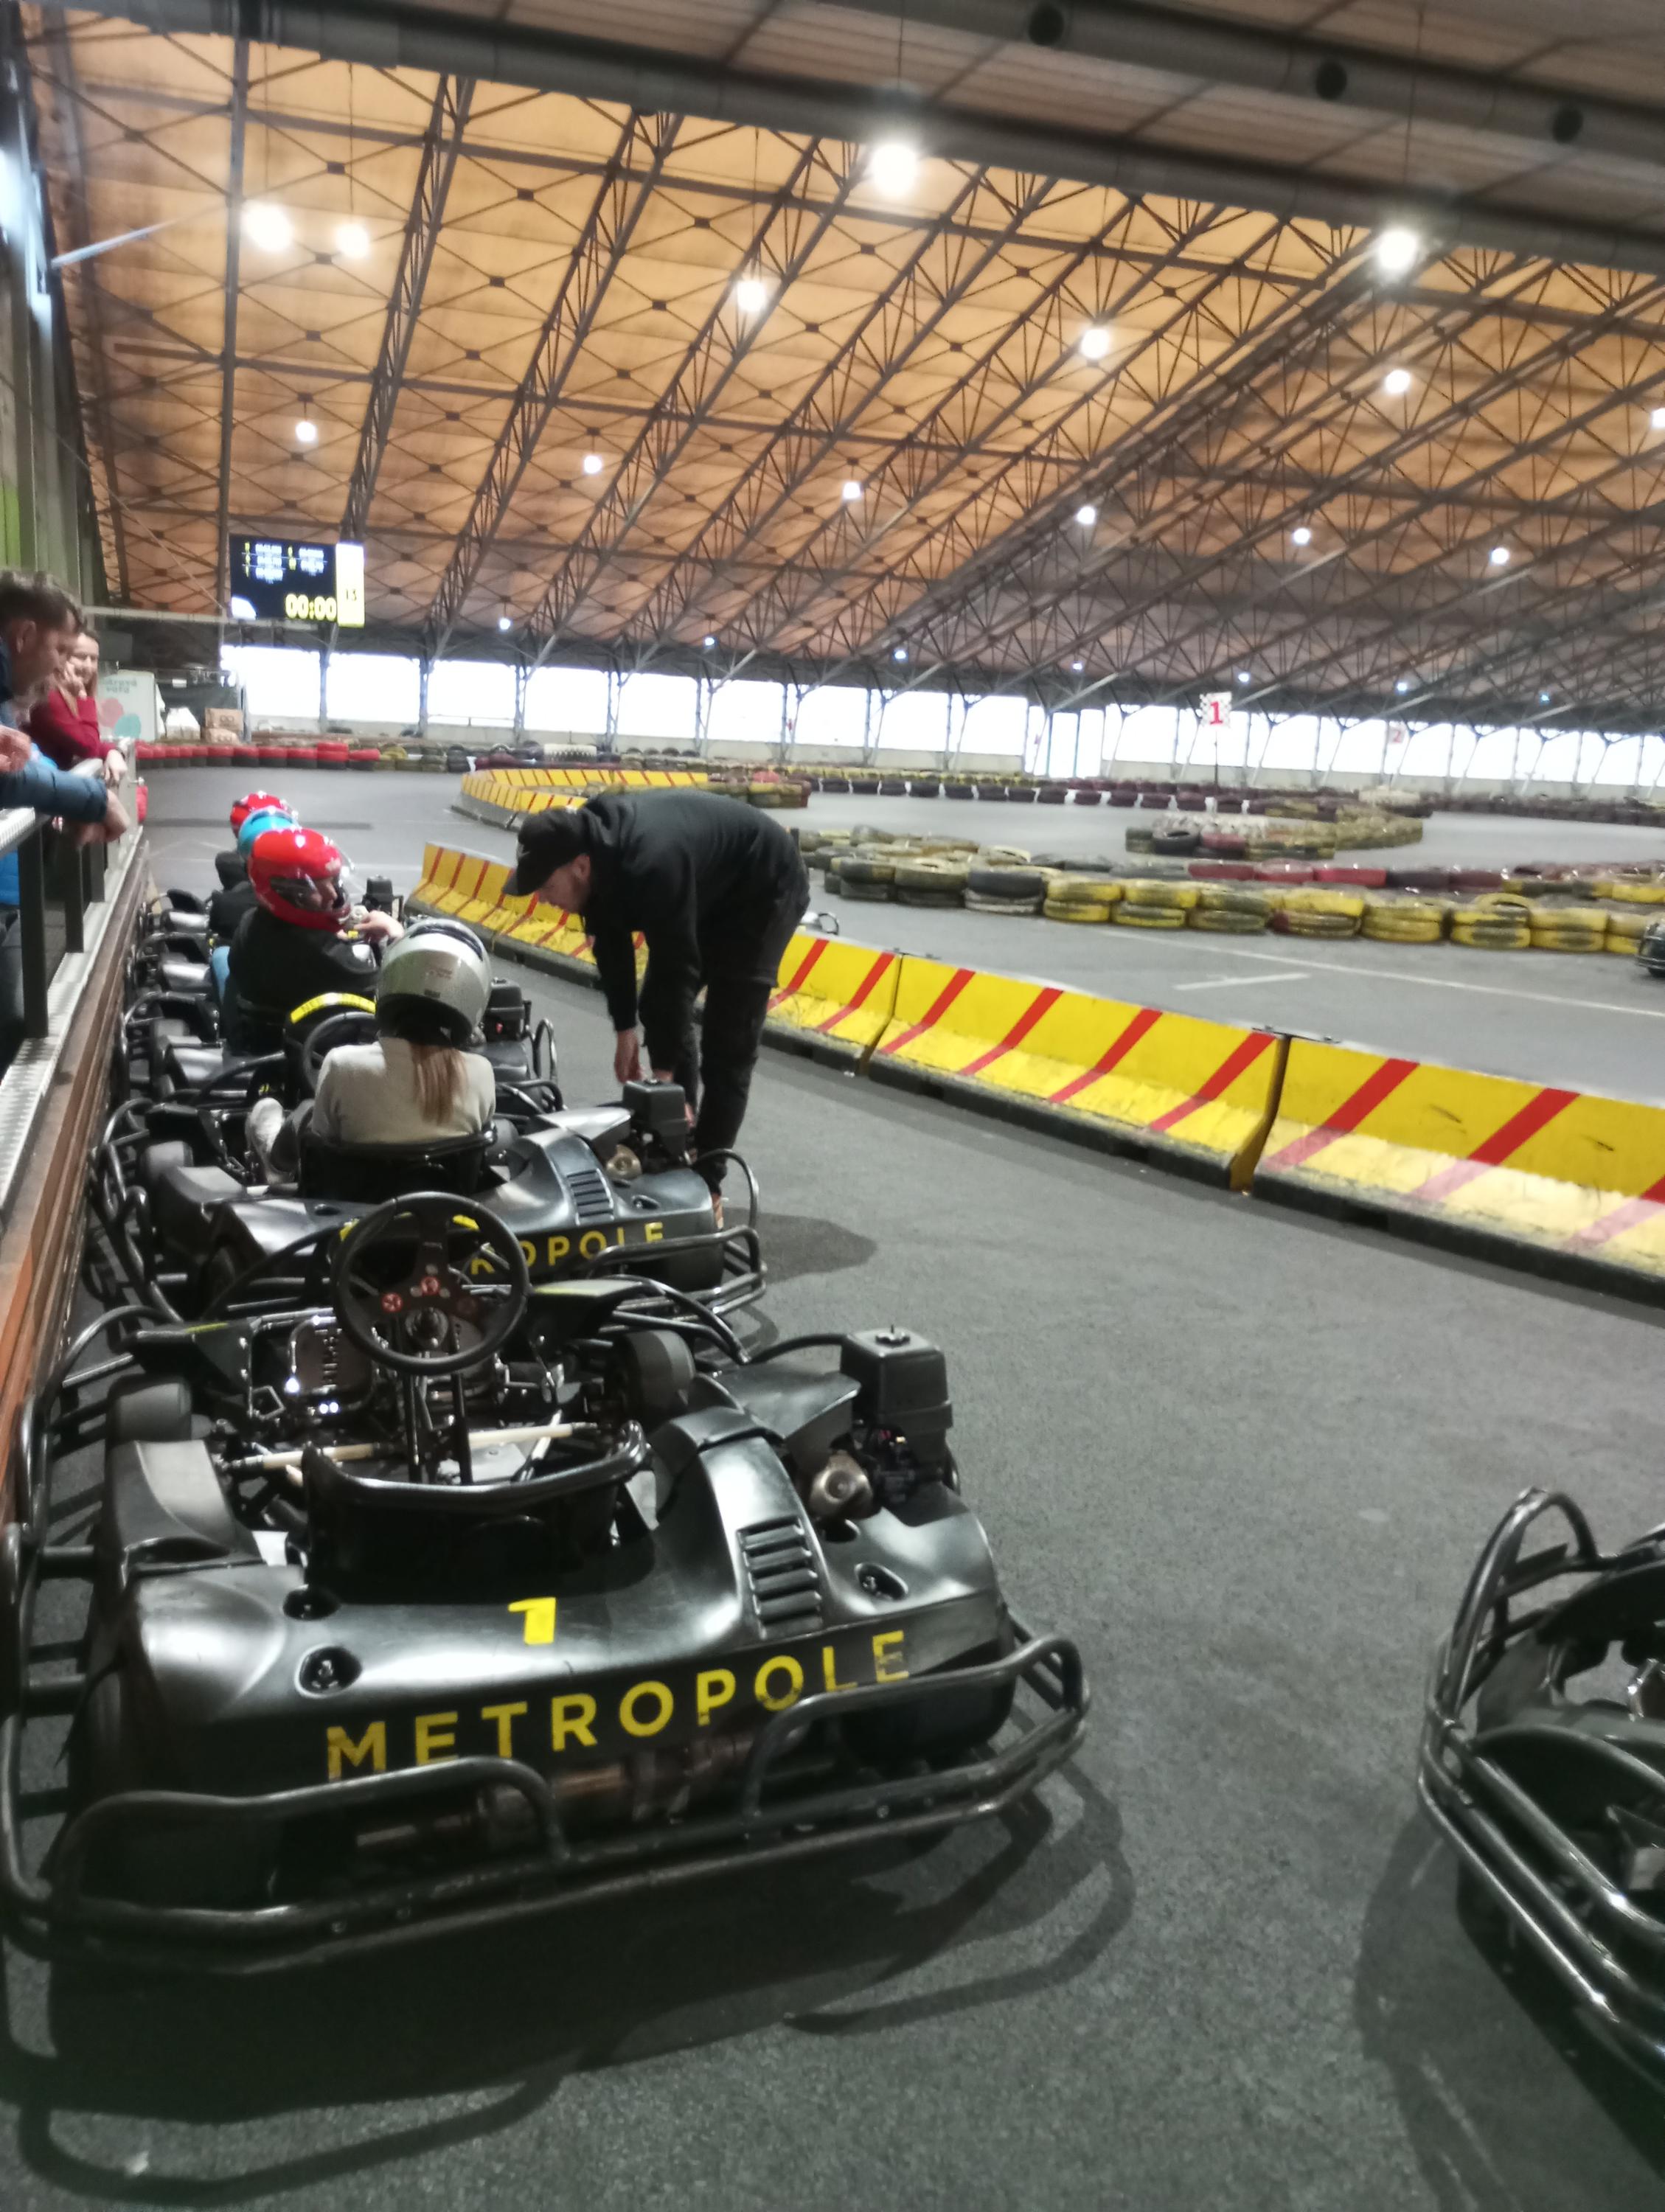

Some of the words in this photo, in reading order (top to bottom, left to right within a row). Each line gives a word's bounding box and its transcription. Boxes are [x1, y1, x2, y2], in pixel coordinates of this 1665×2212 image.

[285, 593, 336, 622] 00:00
[1210, 701, 1223, 725] 1
[507, 1596, 556, 1645] 1
[326, 1630, 911, 1781] METROPOLE
